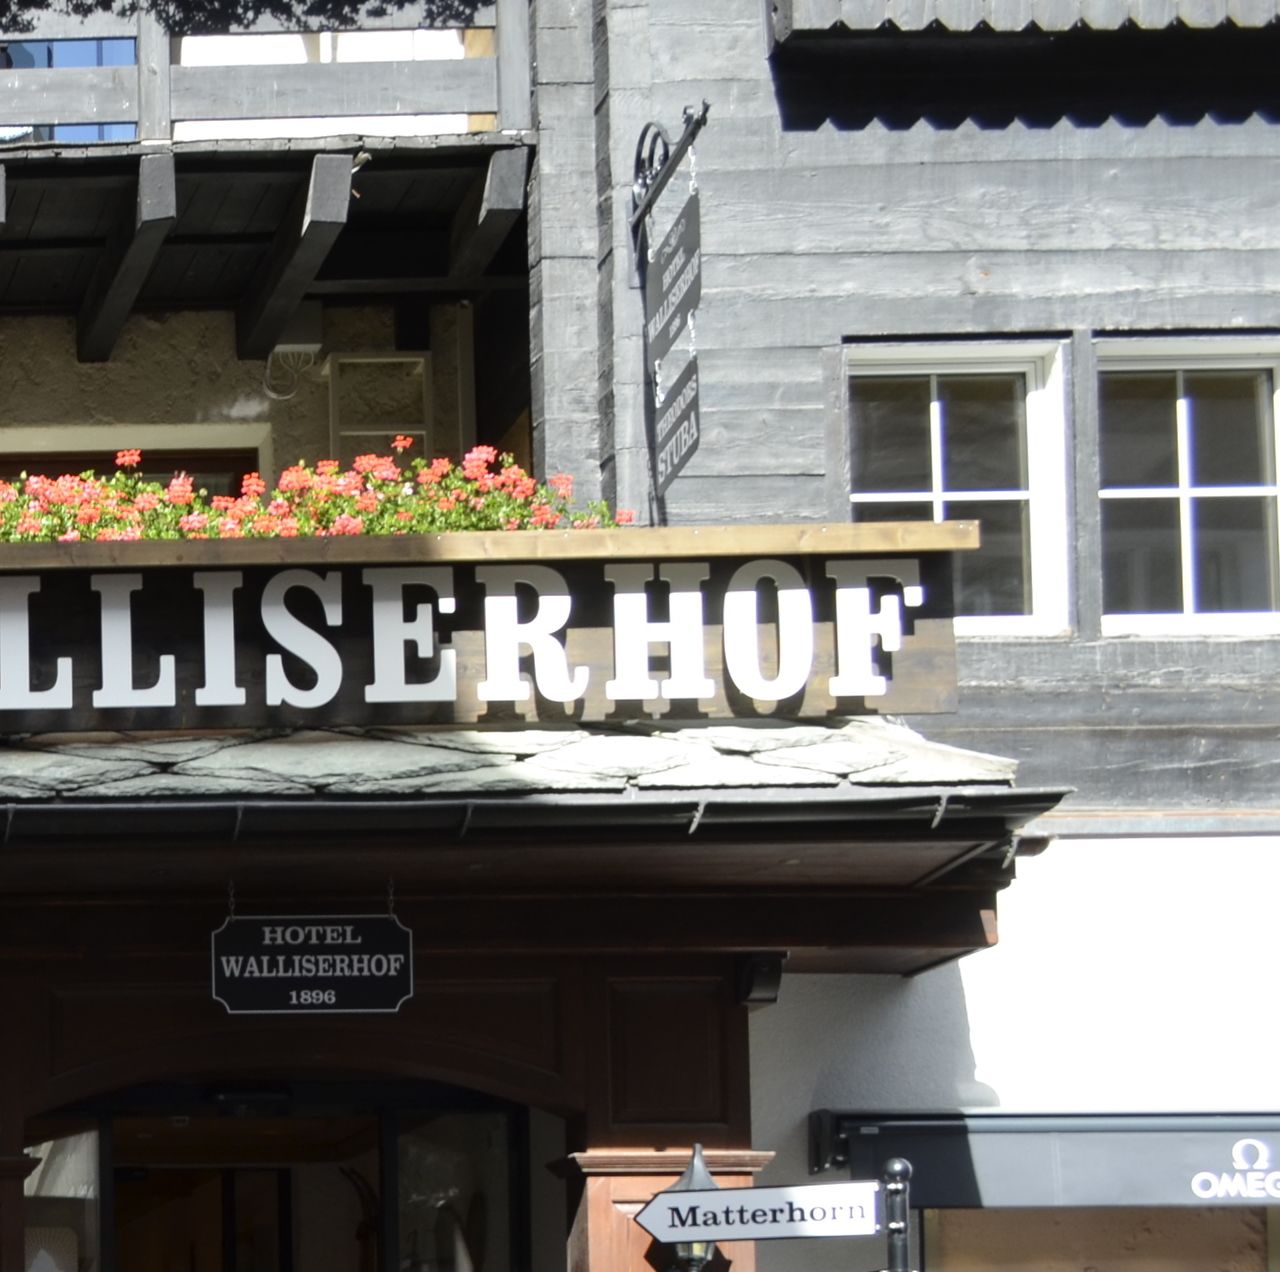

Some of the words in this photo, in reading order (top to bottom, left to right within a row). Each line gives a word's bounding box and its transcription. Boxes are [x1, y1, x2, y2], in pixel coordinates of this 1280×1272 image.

[657, 410, 698, 484] STUBA
[260, 922, 362, 944] HOTEL
[220, 954, 403, 982] WALLISERHOF
[288, 986, 334, 1004] 1896
[1190, 1172, 1280, 1198] OMEG
[667, 1200, 868, 1229] Matterhorn
